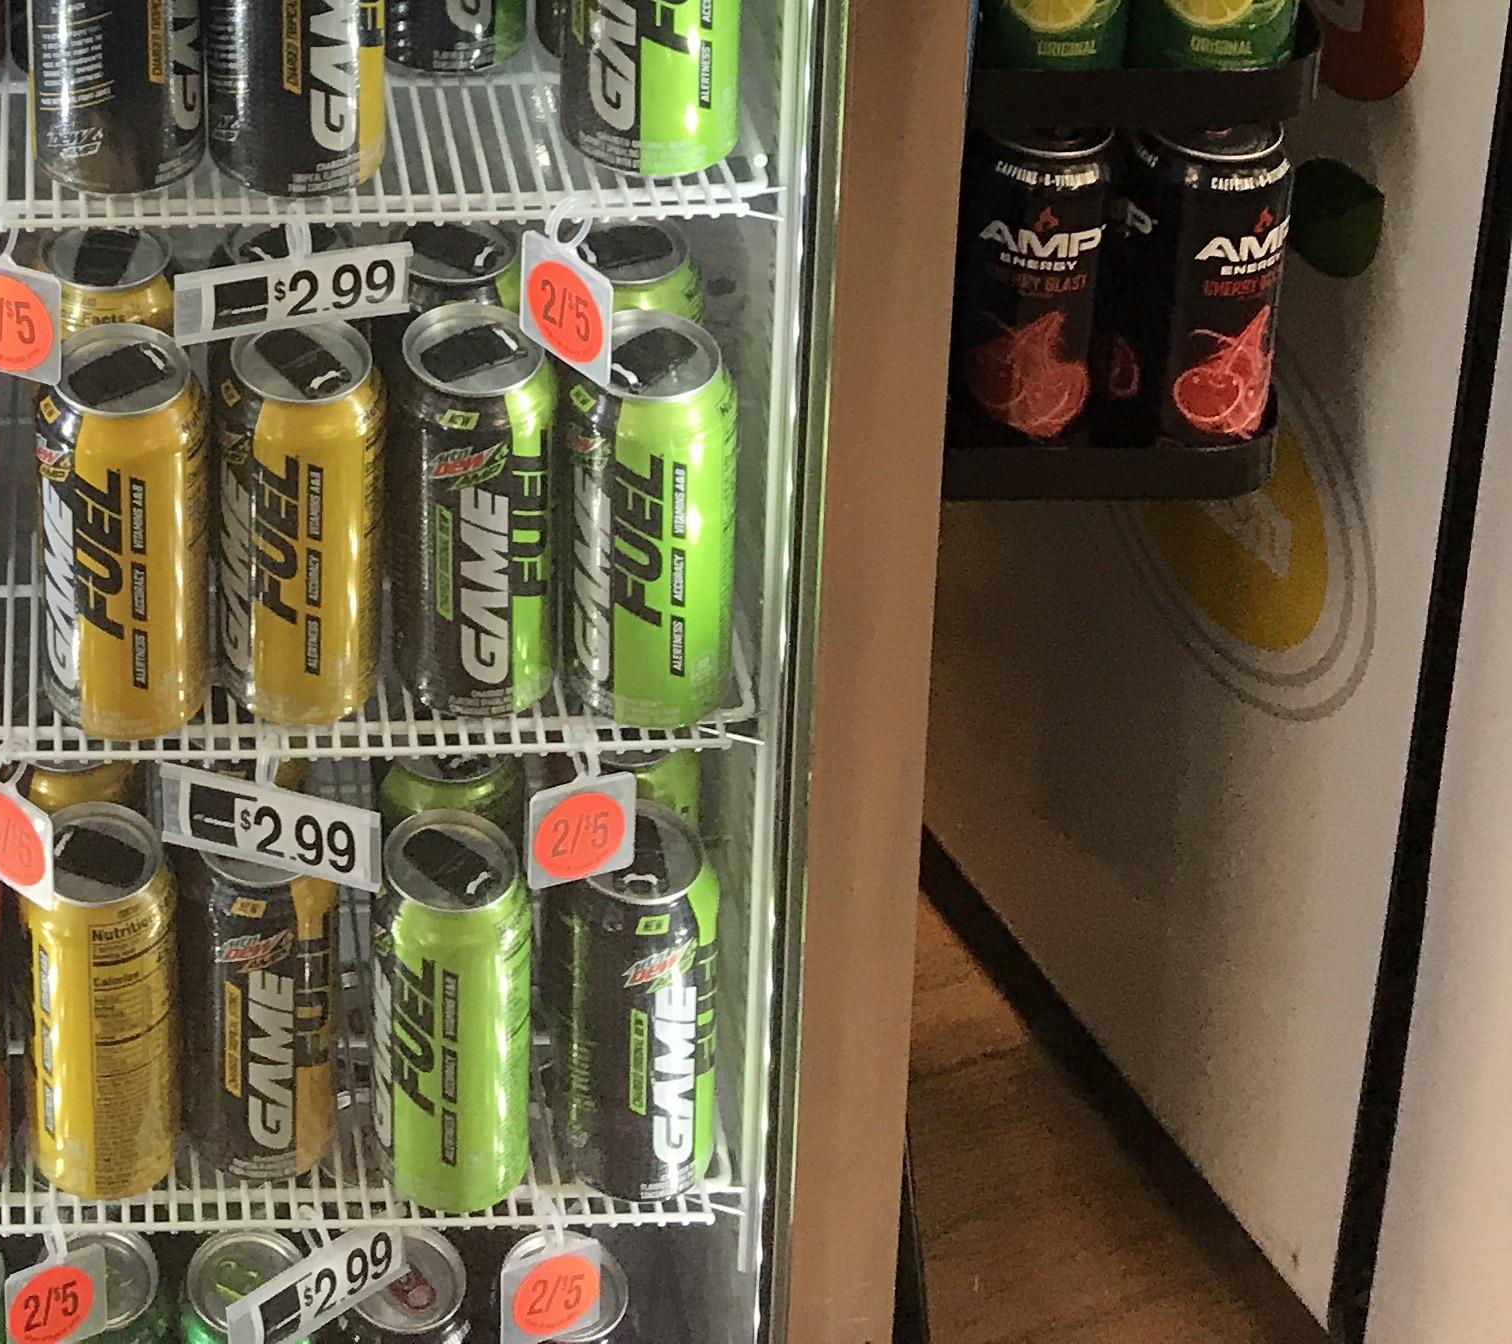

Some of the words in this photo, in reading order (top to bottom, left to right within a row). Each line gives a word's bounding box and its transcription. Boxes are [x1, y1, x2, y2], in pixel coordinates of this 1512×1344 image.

[1037, 38, 1097, 57] ORIGINAL
[1190, 35, 1253, 56] ORIGINAL
[700, 47, 711, 103] ALERTNESS
[979, 219, 1102, 258] AMP
[1000, 252, 1079, 272] ENERGY
[1194, 215, 1290, 261] AMP
[273, 259, 397, 319] $2.99
[132, 507, 144, 549] VITAMINS
[254, 454, 301, 626] FUEL
[613, 454, 665, 627] FUEL
[674, 491, 686, 535] VITAMINS
[74, 466, 126, 641] FUEL
[220, 461, 256, 680] GAME
[673, 553, 685, 602] ACCURACY
[41, 478, 81, 689] GAME
[133, 568, 145, 615] ACCURACY
[460, 487, 512, 685] GAME
[135, 634, 146, 684] ALERTNESS
[672, 621, 684, 671] ALERTNESS
[241, 806, 357, 874] $2.99
[248, 971, 296, 1150] GAME
[392, 956, 437, 1117] FUEL
[651, 986, 698, 1165] GAME
[302, 1239, 394, 1314] $2.99
